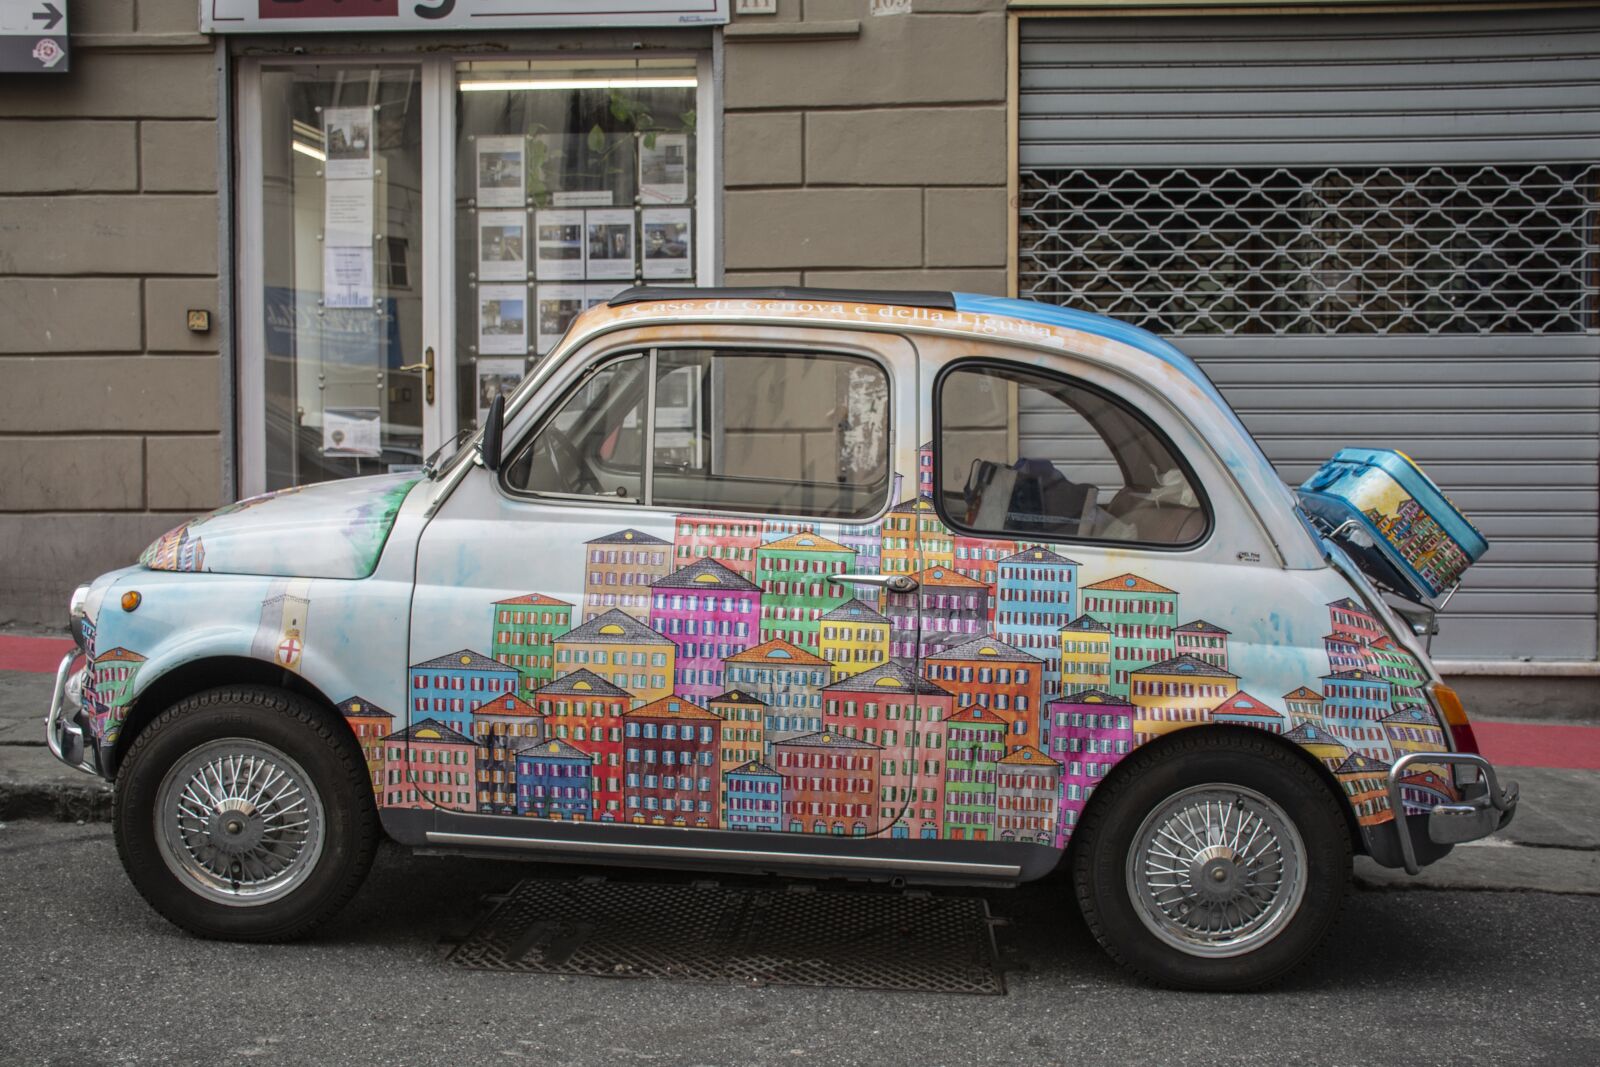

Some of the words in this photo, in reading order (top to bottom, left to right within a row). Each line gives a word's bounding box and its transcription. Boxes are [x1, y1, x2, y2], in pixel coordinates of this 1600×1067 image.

[632, 301, 695, 314] Case
[705, 300, 730, 311] di
[742, 300, 845, 316] Genova
[854, 303, 870, 317] e
[878, 305, 945, 322] della
[956, 312, 1051, 337] Liguria
